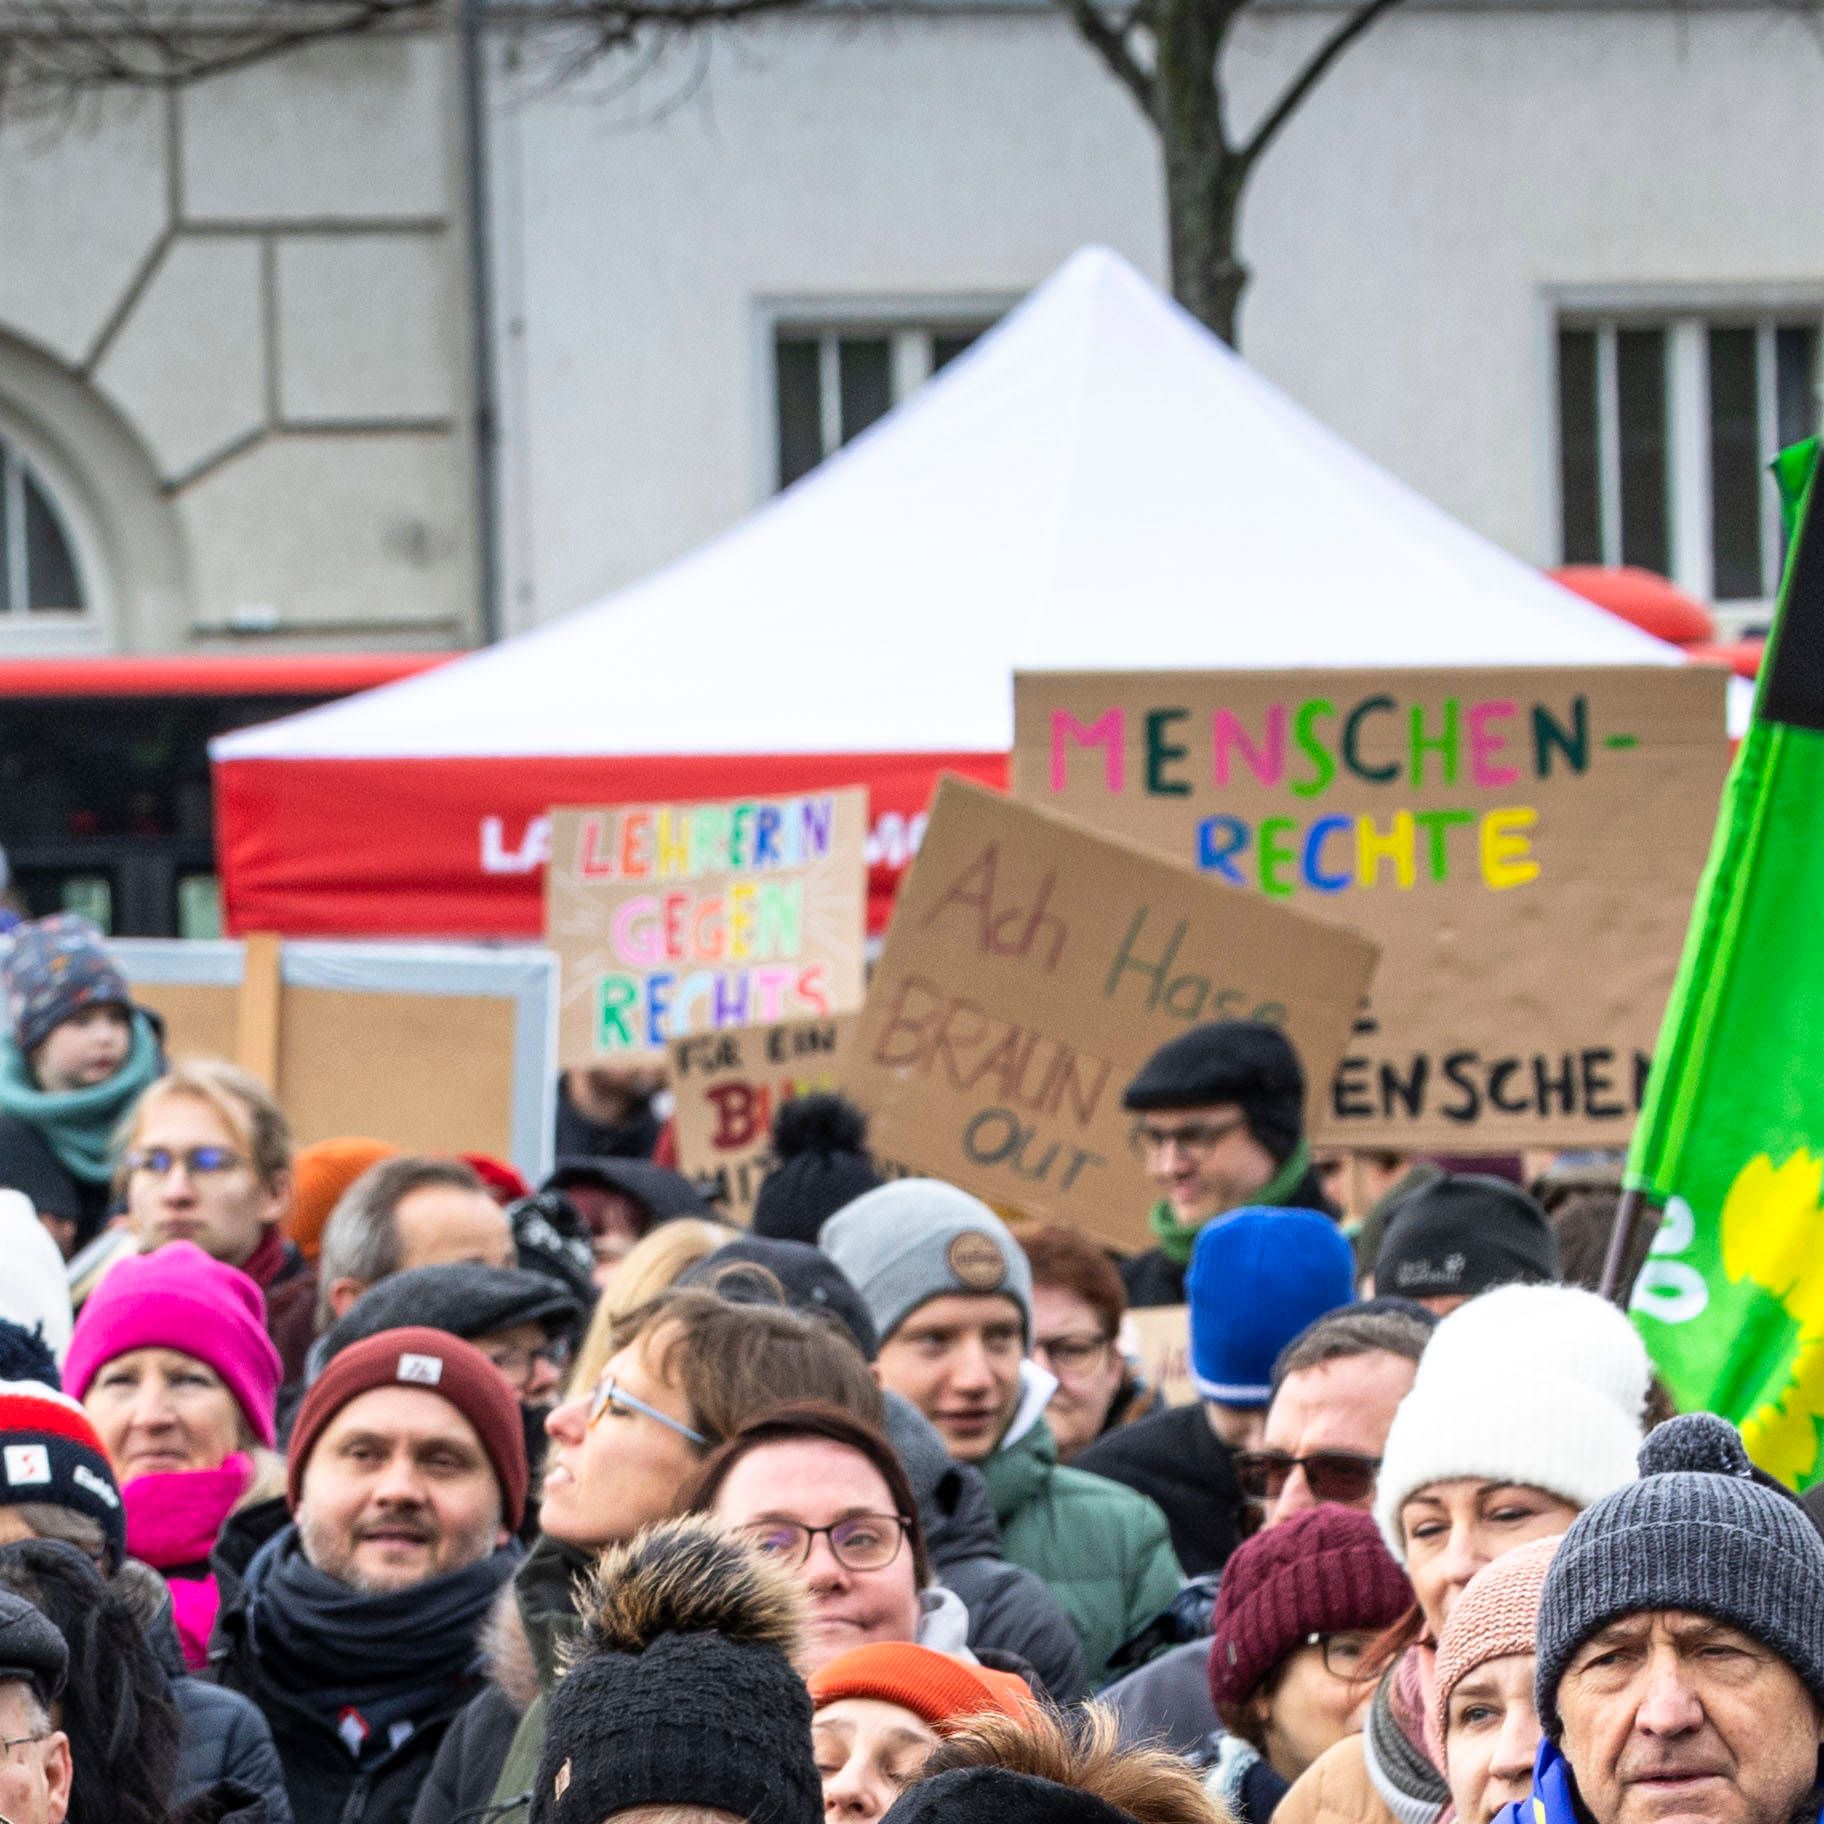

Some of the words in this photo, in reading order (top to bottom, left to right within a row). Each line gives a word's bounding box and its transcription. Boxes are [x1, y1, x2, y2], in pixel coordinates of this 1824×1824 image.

[1048, 693, 1640, 799] MENSCHEN-
[1196, 805, 1542, 899] RECHTE
[611, 882, 804, 966] GEGEN
[920, 838, 1070, 974] Ach
[596, 963, 830, 1048] RECHTS
[767, 1026, 838, 1064] EIN
[872, 972, 1116, 1128] BRAUN
[960, 1105, 1108, 1192] OUT
